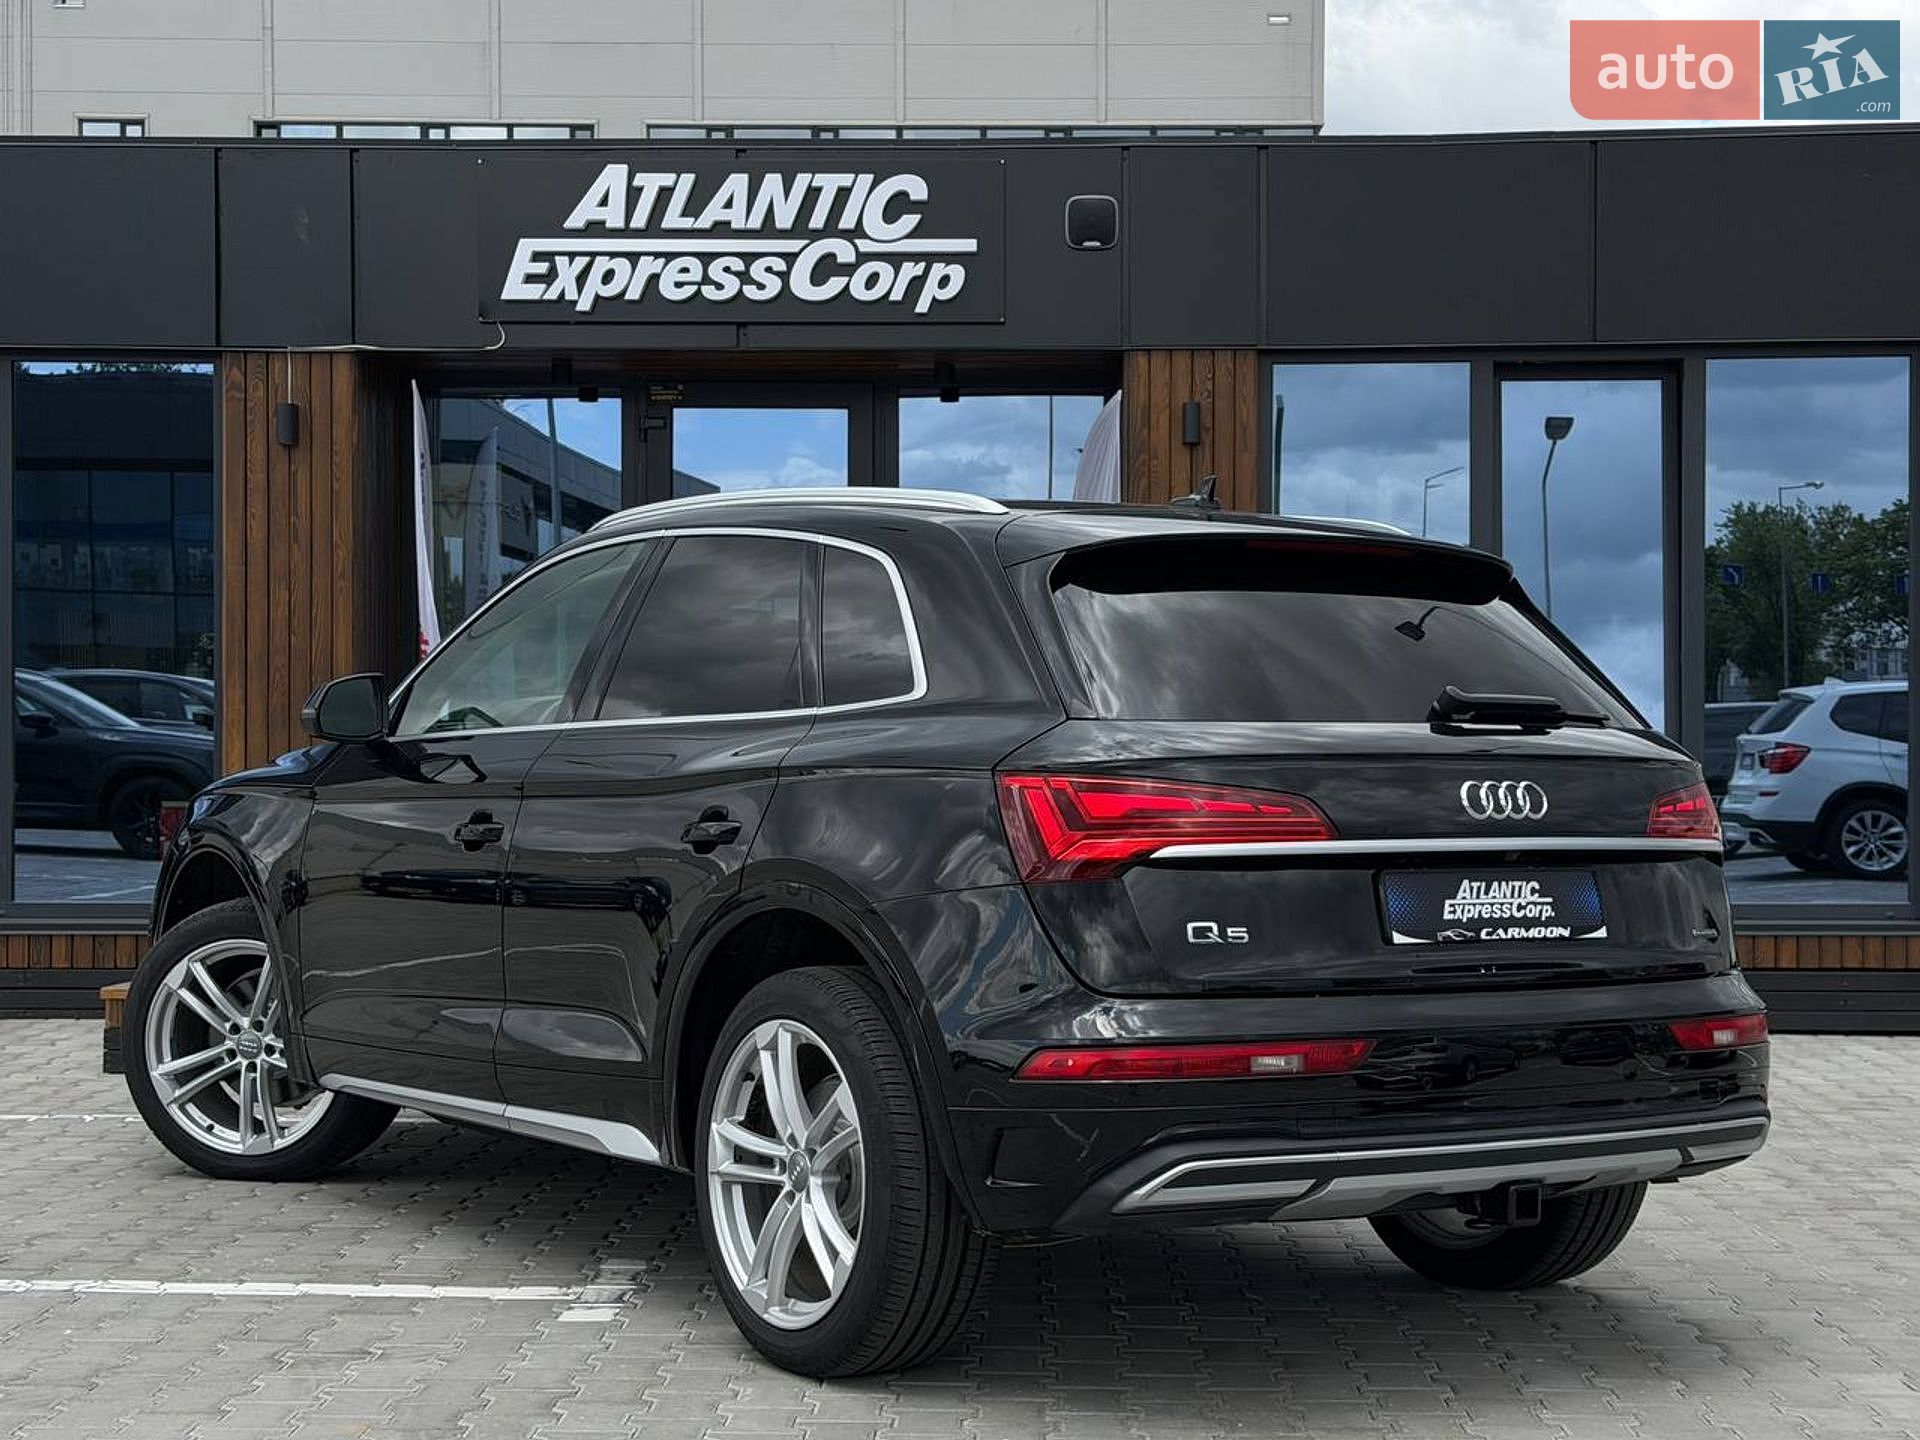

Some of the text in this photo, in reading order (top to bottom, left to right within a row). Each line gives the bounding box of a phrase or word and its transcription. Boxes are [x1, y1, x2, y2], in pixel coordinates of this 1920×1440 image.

[563, 163, 929, 242] ATLANTIC
[500, 238, 966, 314] ExpressCorp
[1456, 879, 1540, 900] ATLANTIC
[1186, 921, 1249, 944] Q5
[1480, 926, 1571, 940] CARMOON
